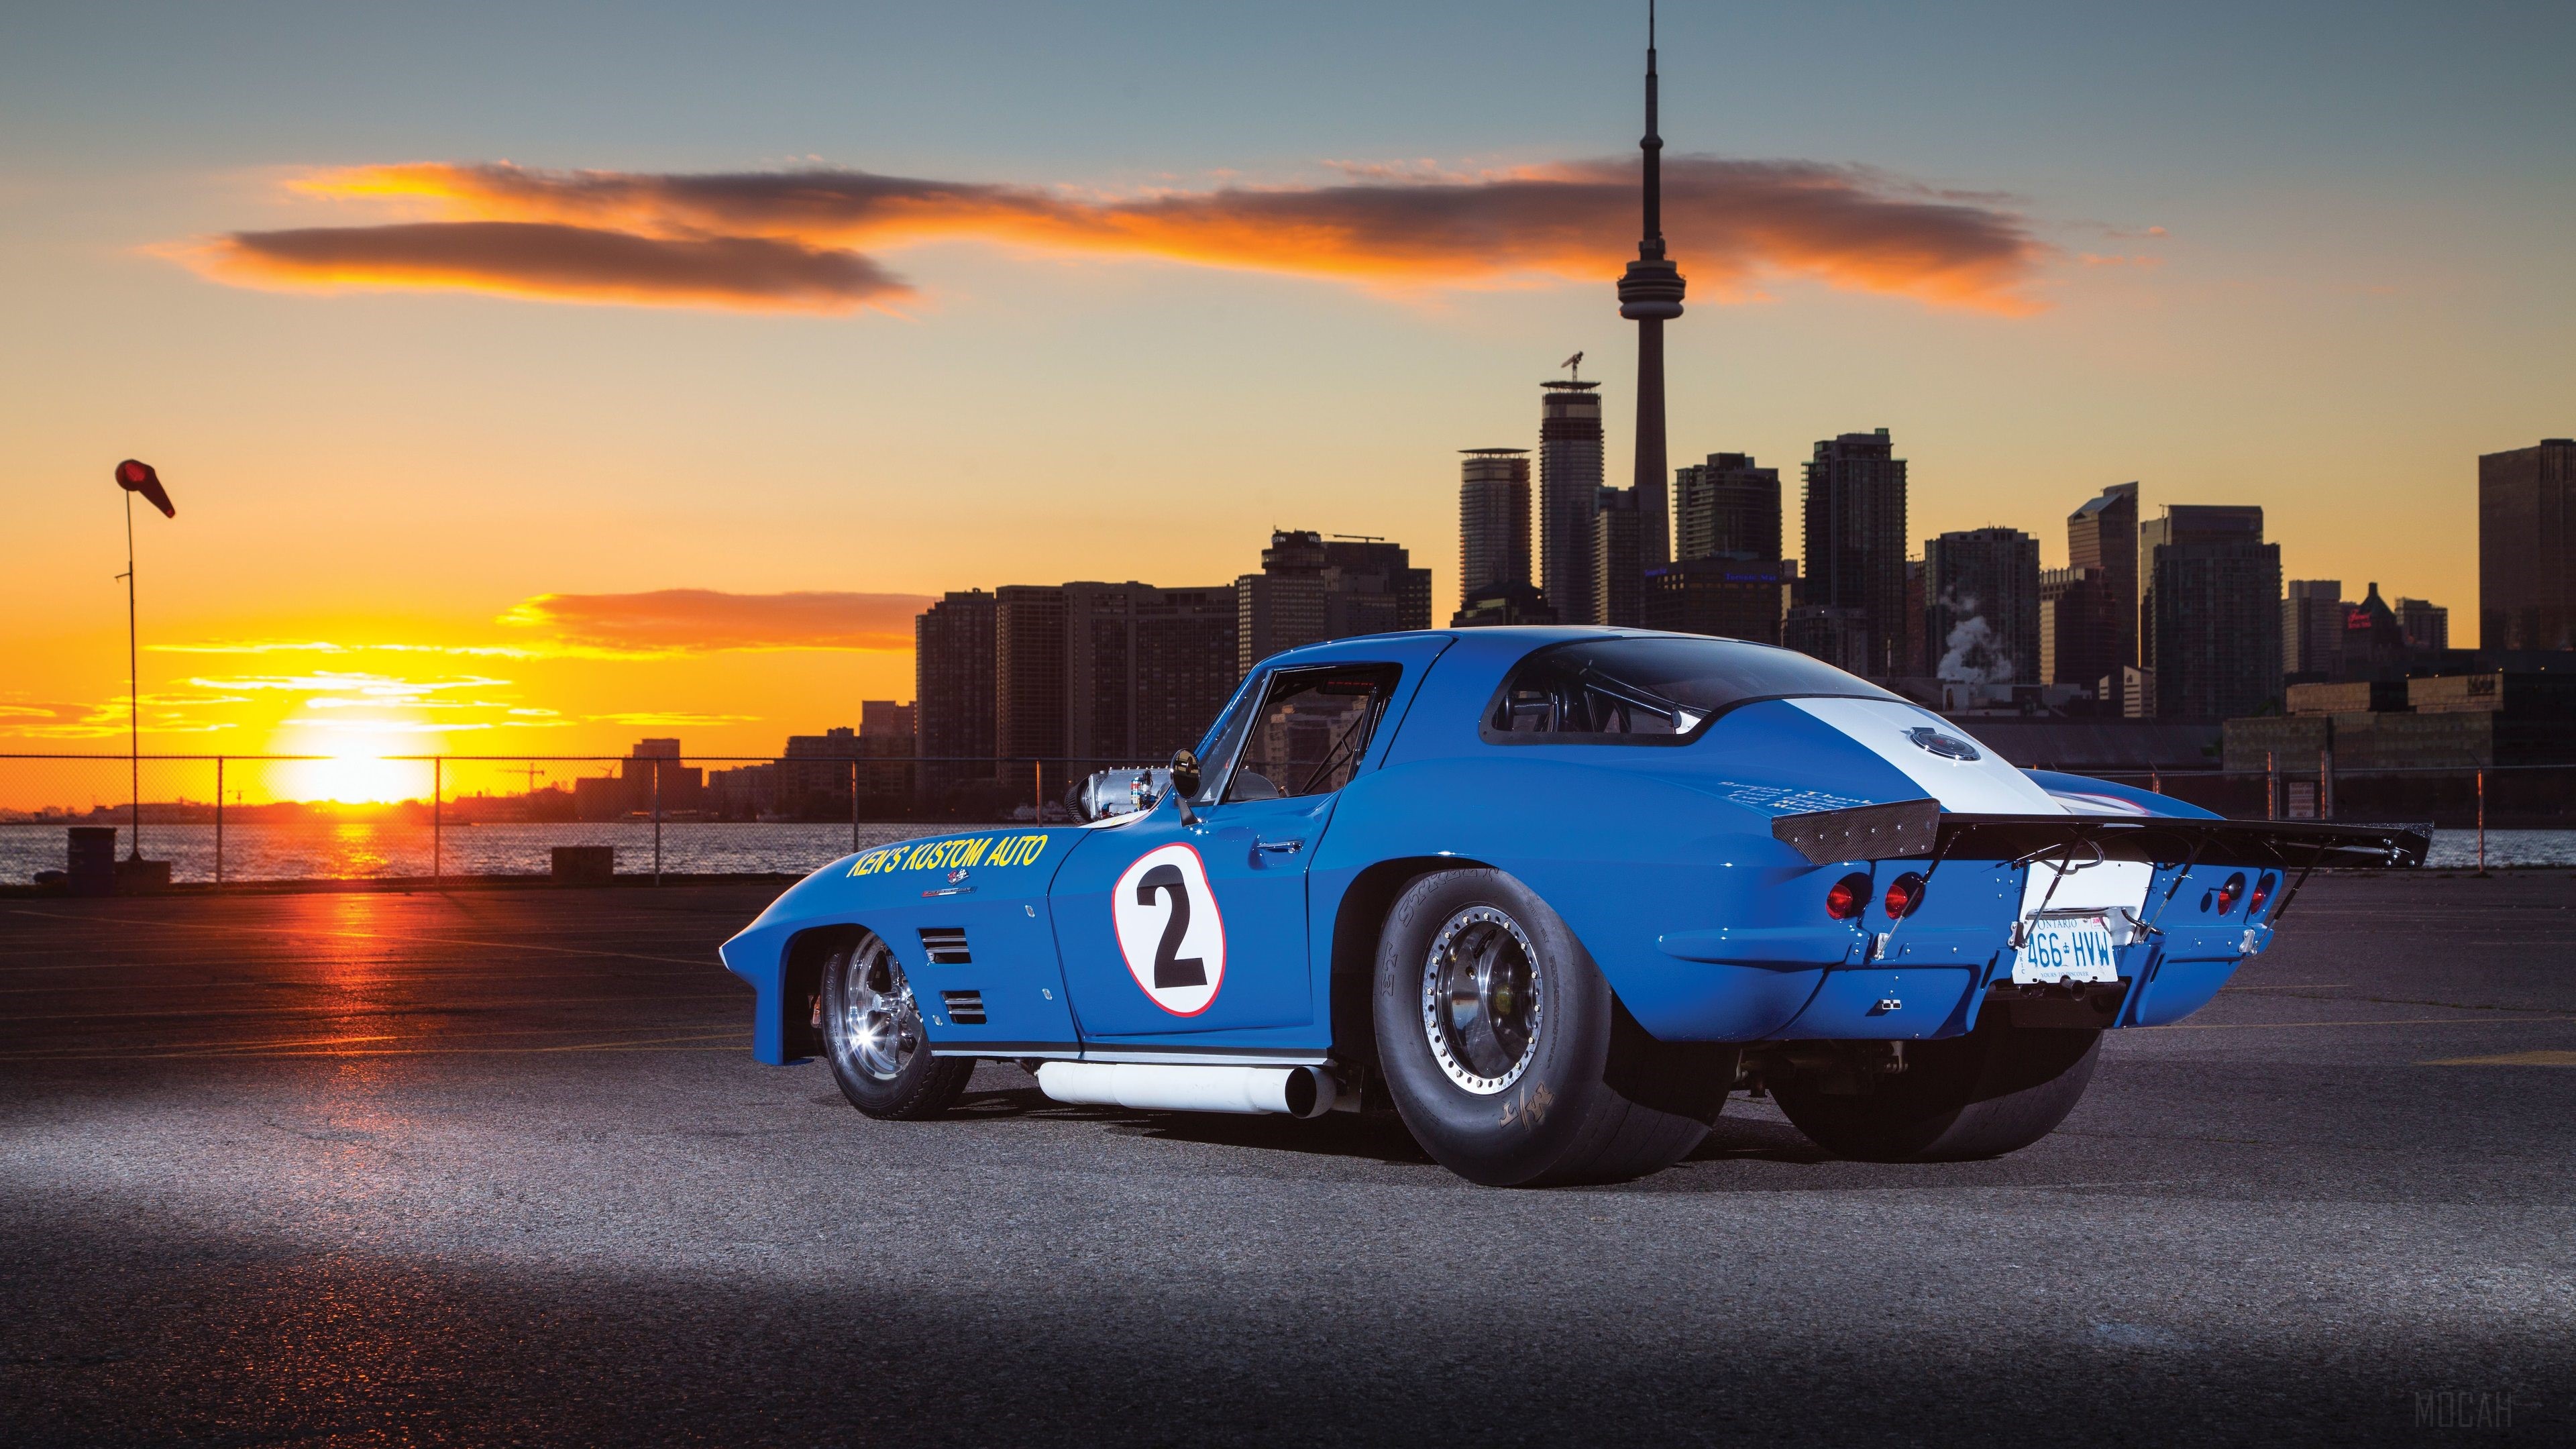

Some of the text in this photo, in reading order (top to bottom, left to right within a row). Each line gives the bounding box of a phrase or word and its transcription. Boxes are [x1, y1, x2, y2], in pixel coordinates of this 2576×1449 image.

[846, 835, 1049, 878] KEN'S KUSTOM AUTO
[1136, 864, 1208, 989] 2
[2037, 918, 2077, 930] ONTARIO
[2028, 932, 2110, 968] 466 HVW
